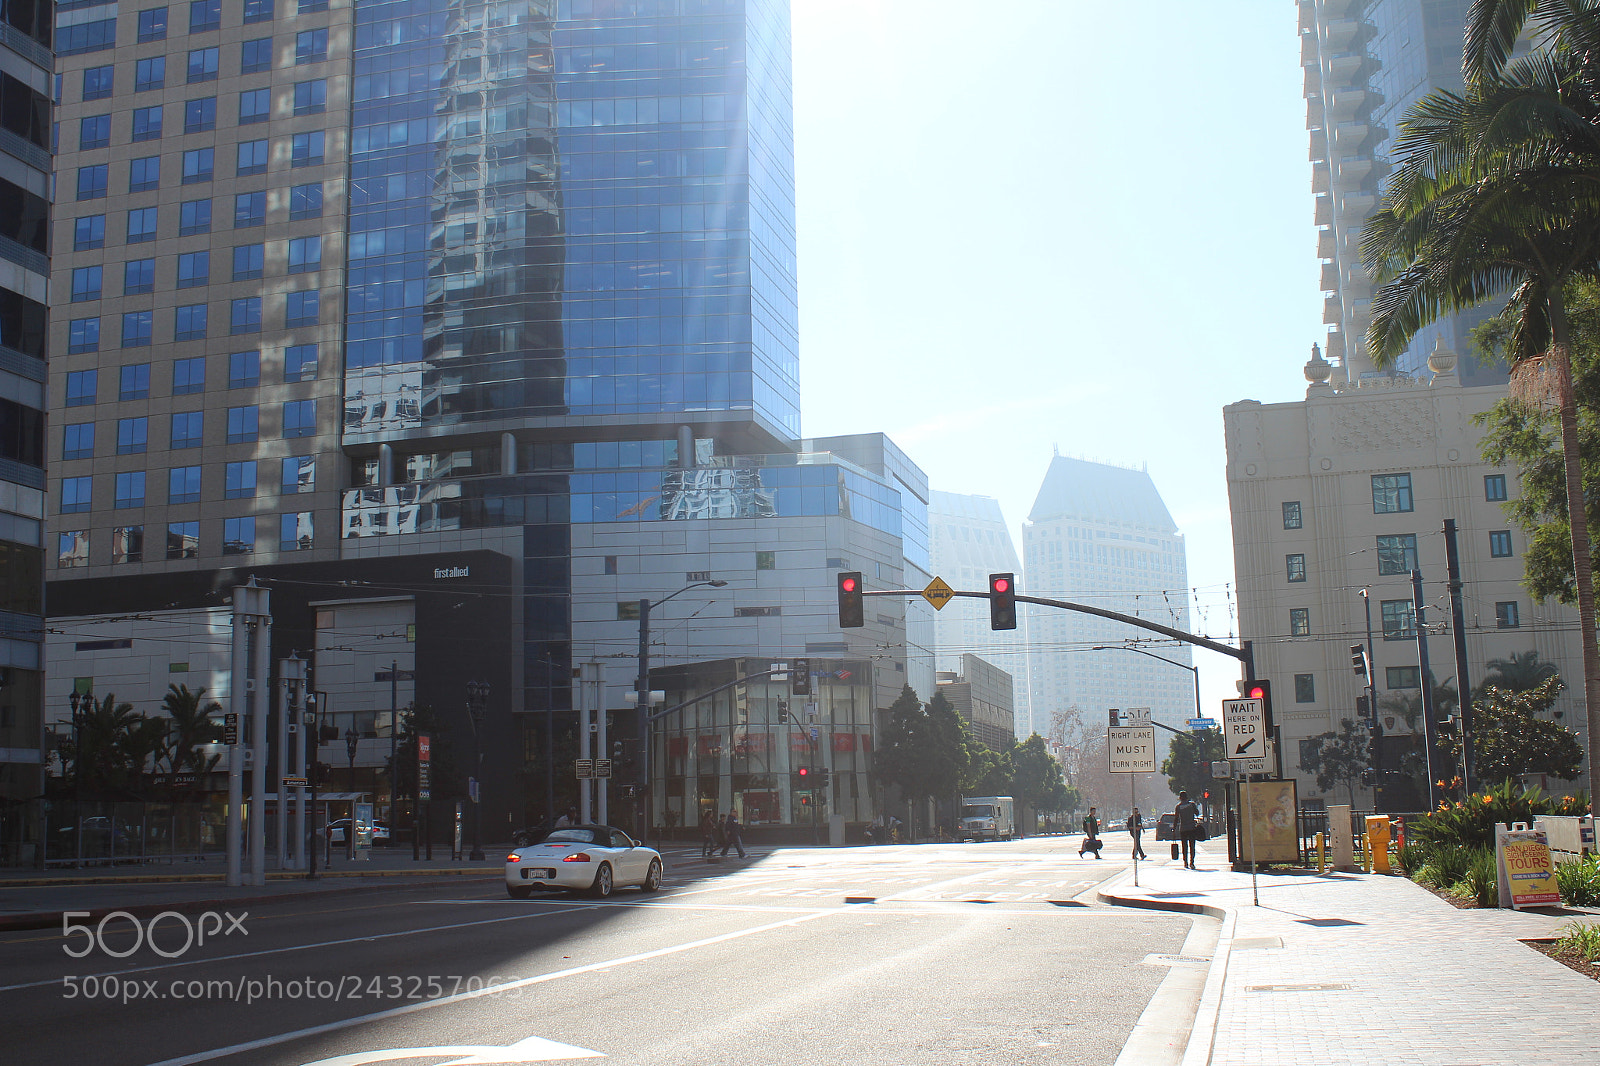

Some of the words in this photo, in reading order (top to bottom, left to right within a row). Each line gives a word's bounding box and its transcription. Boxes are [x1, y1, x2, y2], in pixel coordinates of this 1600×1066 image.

[1229, 702, 1256, 714] WAIT
[1227, 715, 1247, 723] HERE
[1249, 714, 1260, 722] ON
[1233, 724, 1256, 735] RED
[1111, 731, 1131, 739] RIGHT
[1133, 731, 1151, 739] LANE
[1116, 745, 1147, 754] MUST
[1112, 760, 1130, 768] TURN
[1133, 760, 1152, 768] RIGHT
[1507, 857, 1549, 869] TOURS
